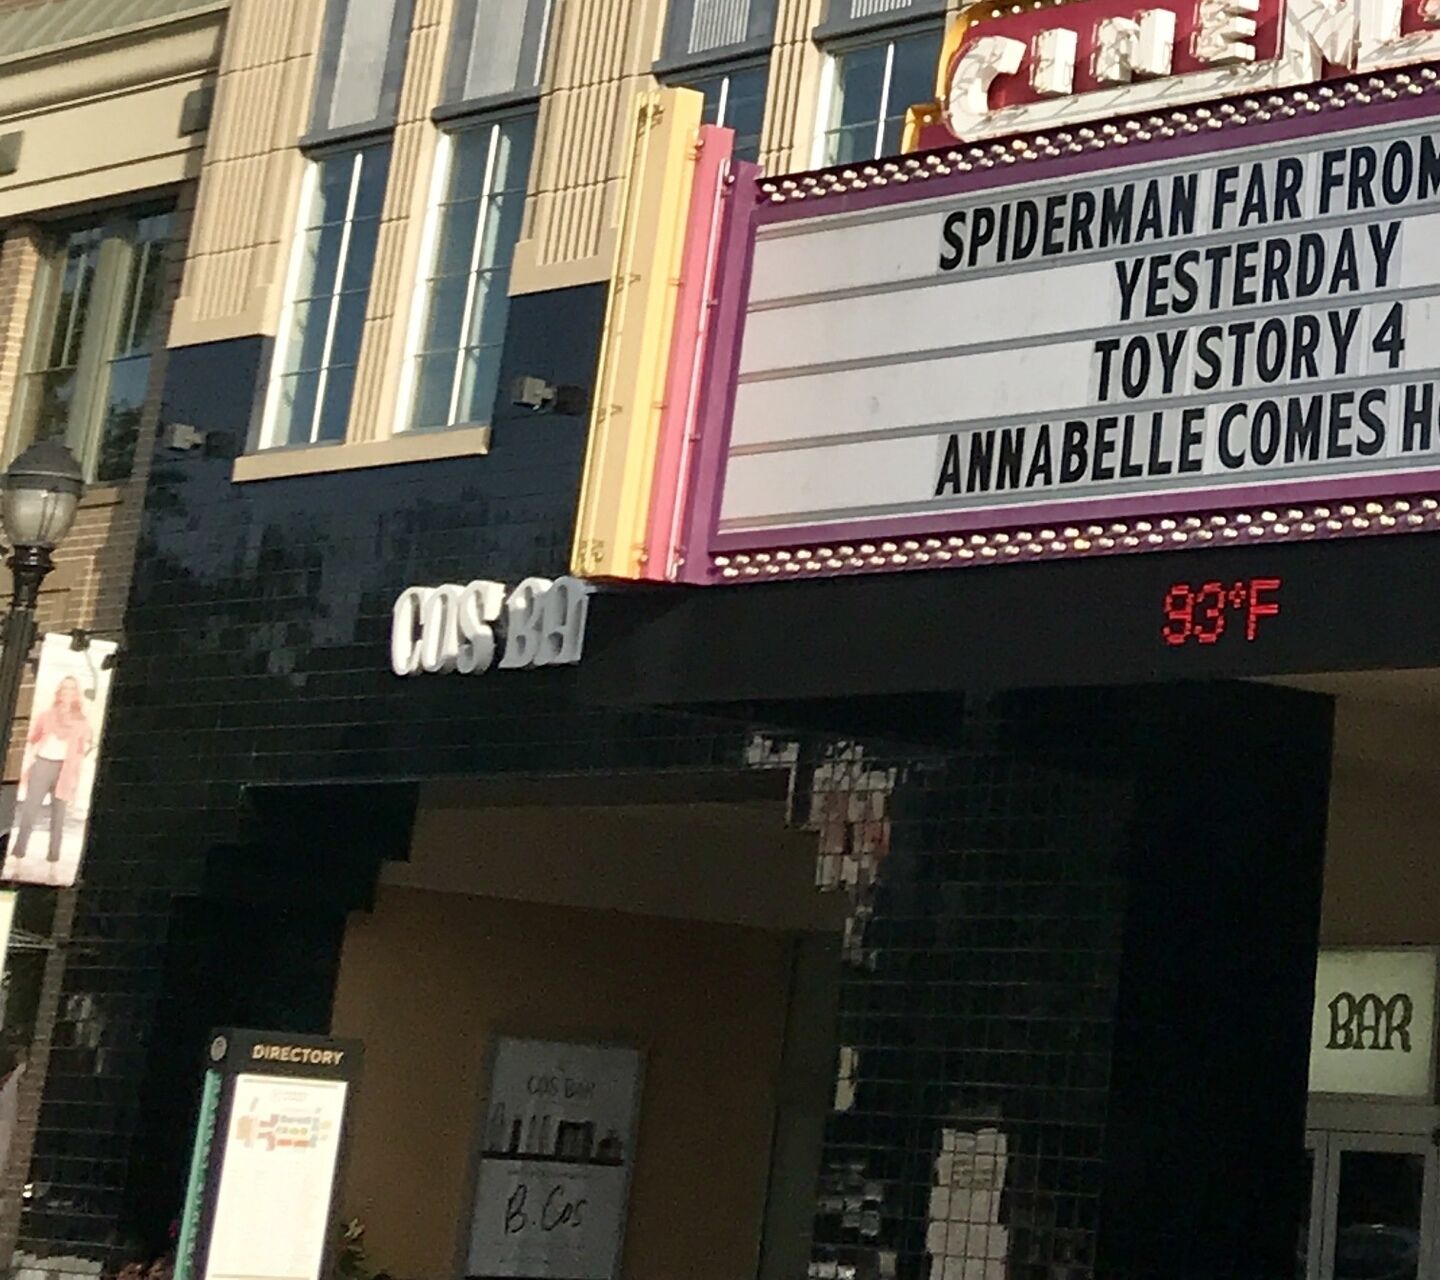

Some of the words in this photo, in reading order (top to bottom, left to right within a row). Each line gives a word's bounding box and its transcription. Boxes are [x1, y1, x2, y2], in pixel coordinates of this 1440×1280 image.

[937, 174, 1199, 271] SPIDERMAN
[1210, 156, 1303, 230] FAR
[1114, 221, 1402, 320] YESTERDAY
[1094, 329, 1184, 401] TOY
[1194, 307, 1362, 390] STORY
[1371, 301, 1406, 370] 4
[935, 408, 1204, 496] ANNABELLE
[1216, 388, 1387, 469] COMES
[391, 579, 505, 675] COS
[498, 576, 592, 669] BA
[1161, 578, 1282, 646] 93°F
[252, 1043, 344, 1065] DIRECTORY
[1325, 991, 1413, 1053] BAR
